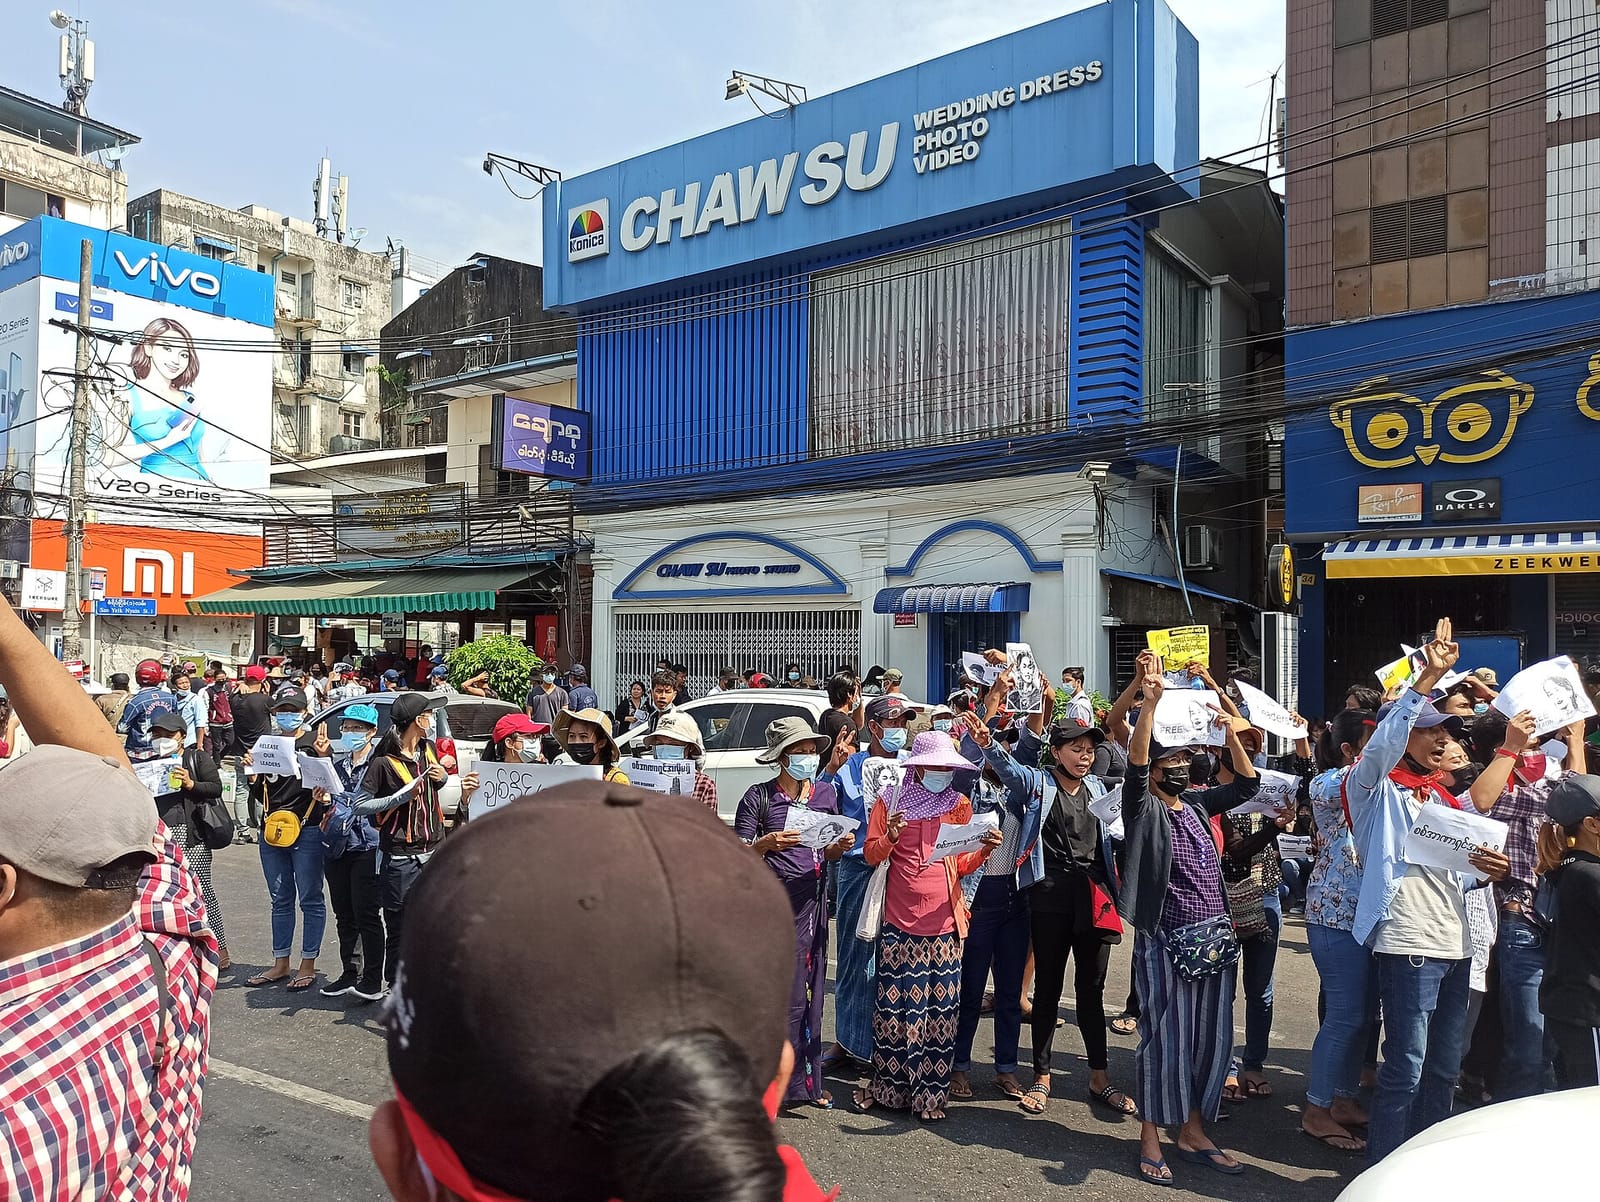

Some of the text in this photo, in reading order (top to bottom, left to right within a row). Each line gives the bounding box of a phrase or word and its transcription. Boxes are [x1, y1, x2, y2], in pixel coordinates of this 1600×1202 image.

[1019, 60, 1103, 101] DRESS
[913, 117, 990, 154] PHOTO
[912, 141, 980, 174] VIDEO
[620, 121, 900, 252] CHAW SU
[569, 233, 604, 253] Konica
[113, 250, 220, 299] vivo
[9, 316, 30, 331] Series
[96, 477, 221, 502] V20 Series
[1363, 487, 1416, 512] Ray-Ban
[1435, 502, 1496, 511] OAKLEY
[656, 562, 800, 577] CHAW SU PHOTO STUDIO
[1302, 575, 1313, 584] 34
[1160, 726, 1183, 734] FREE
[1277, 784, 1296, 796] Our
